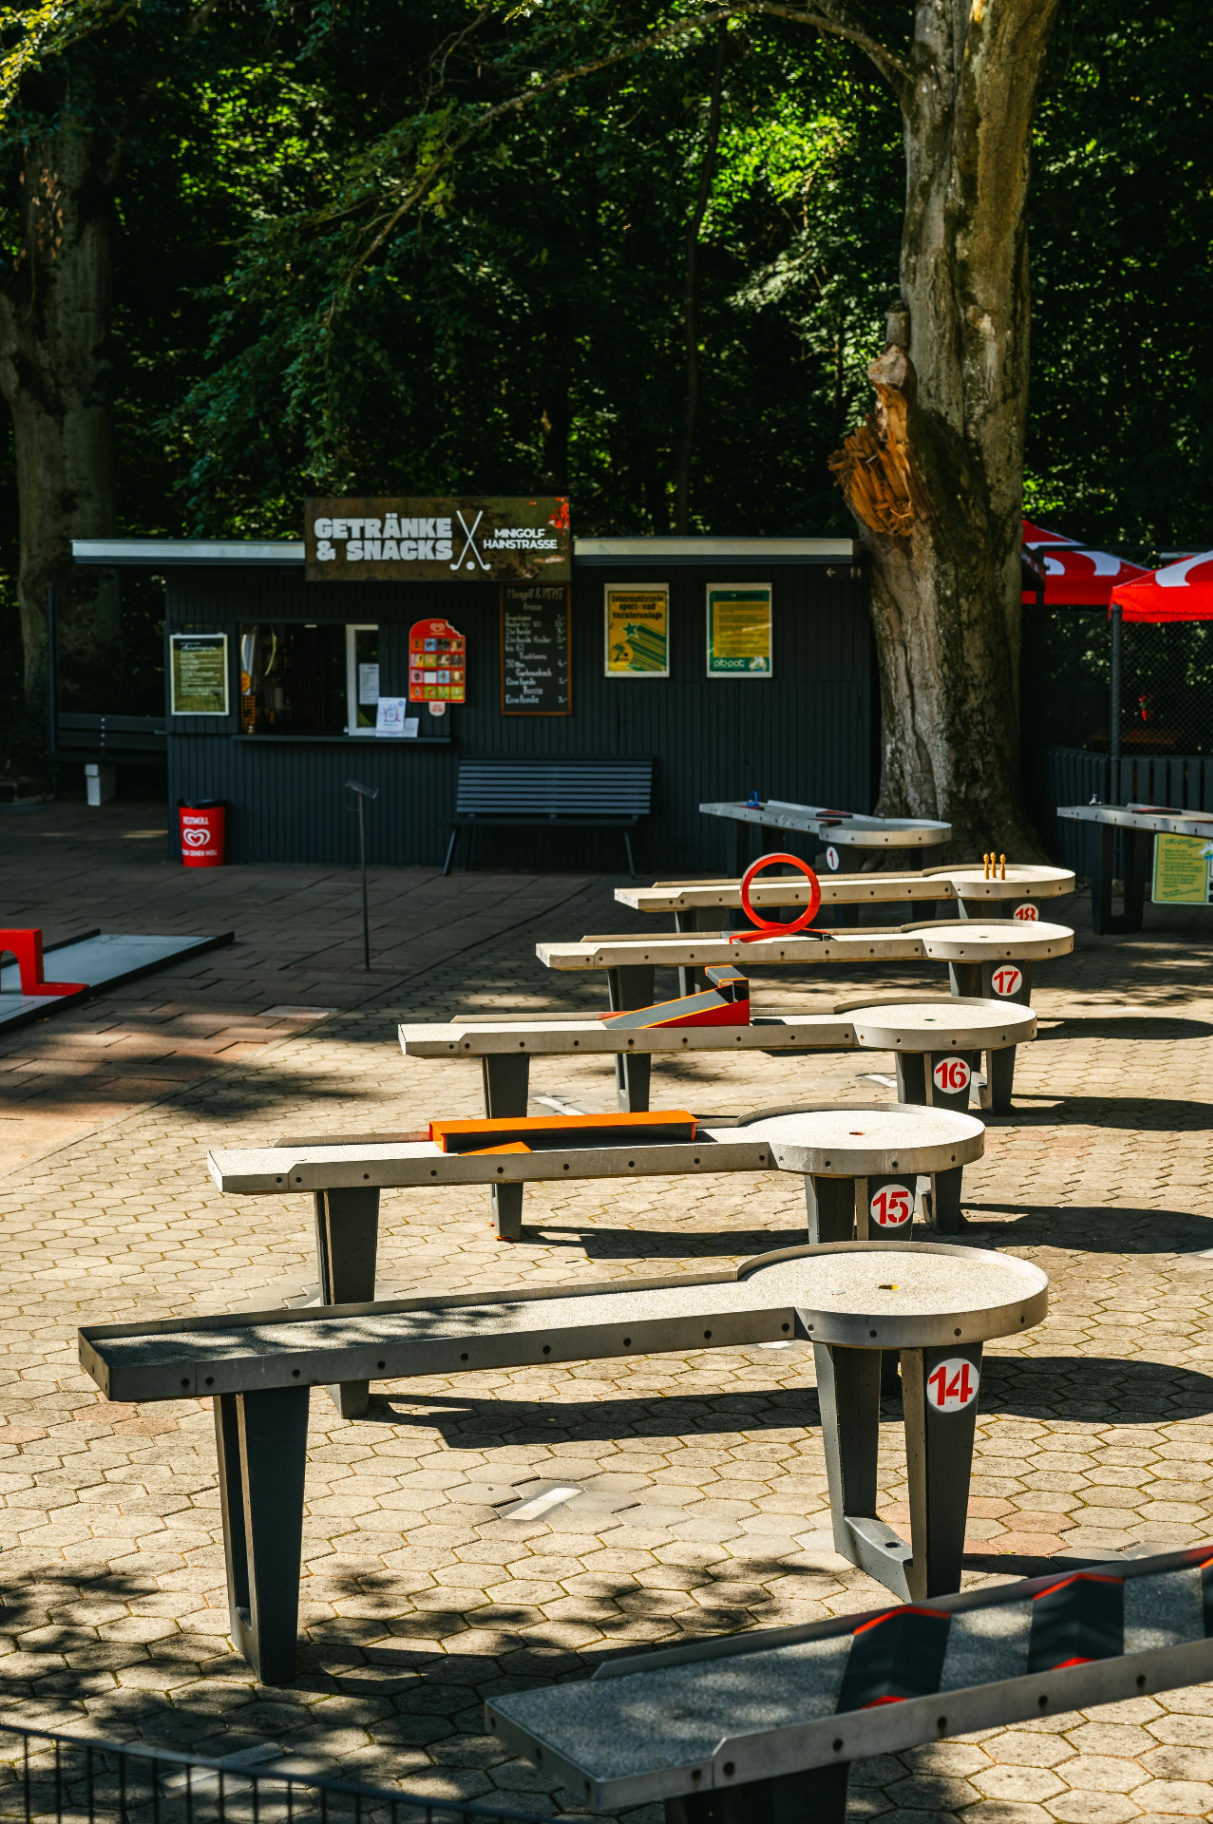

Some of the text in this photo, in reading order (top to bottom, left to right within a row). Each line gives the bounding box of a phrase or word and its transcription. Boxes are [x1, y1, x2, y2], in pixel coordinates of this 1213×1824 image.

[314, 513, 453, 539] GETRÄNKE
[494, 528, 545, 539] MINIGOLF
[316, 540, 453, 561] & SNACKS
[483, 539, 557, 550] HAINSTRASSE
[829, 850, 835, 868] 1
[1015, 907, 1036, 922] 18
[993, 970, 1020, 994] 17
[934, 1061, 968, 1090] 16
[871, 1188, 912, 1227] 15
[928, 1362, 974, 1407] 14
